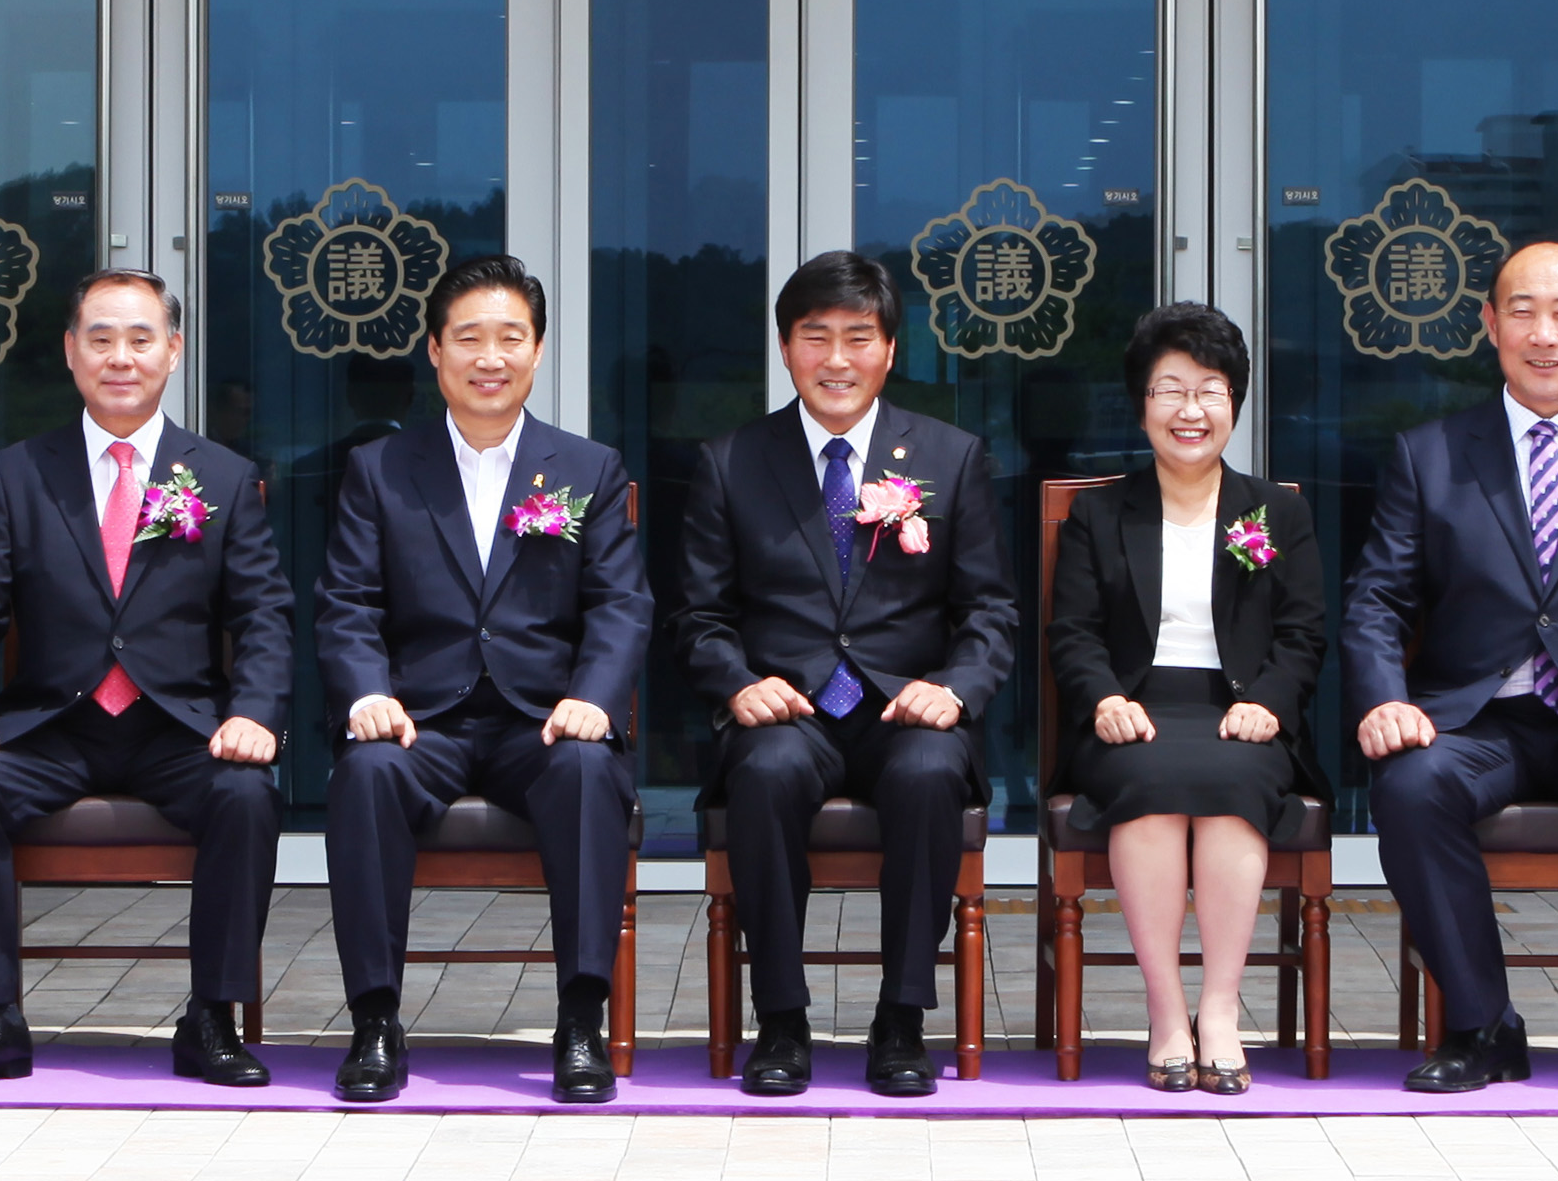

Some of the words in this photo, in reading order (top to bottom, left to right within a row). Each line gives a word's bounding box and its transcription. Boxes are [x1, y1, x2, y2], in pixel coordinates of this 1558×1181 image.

[53, 195, 86, 205] 당기시오
[215, 195, 248, 205] 당기시오
[1104, 192, 1138, 202] 당기시오
[1285, 191, 1318, 201] 당기시오
[327, 243, 386, 302] 議
[973, 243, 1034, 303] 議
[1388, 243, 1448, 303] 議
